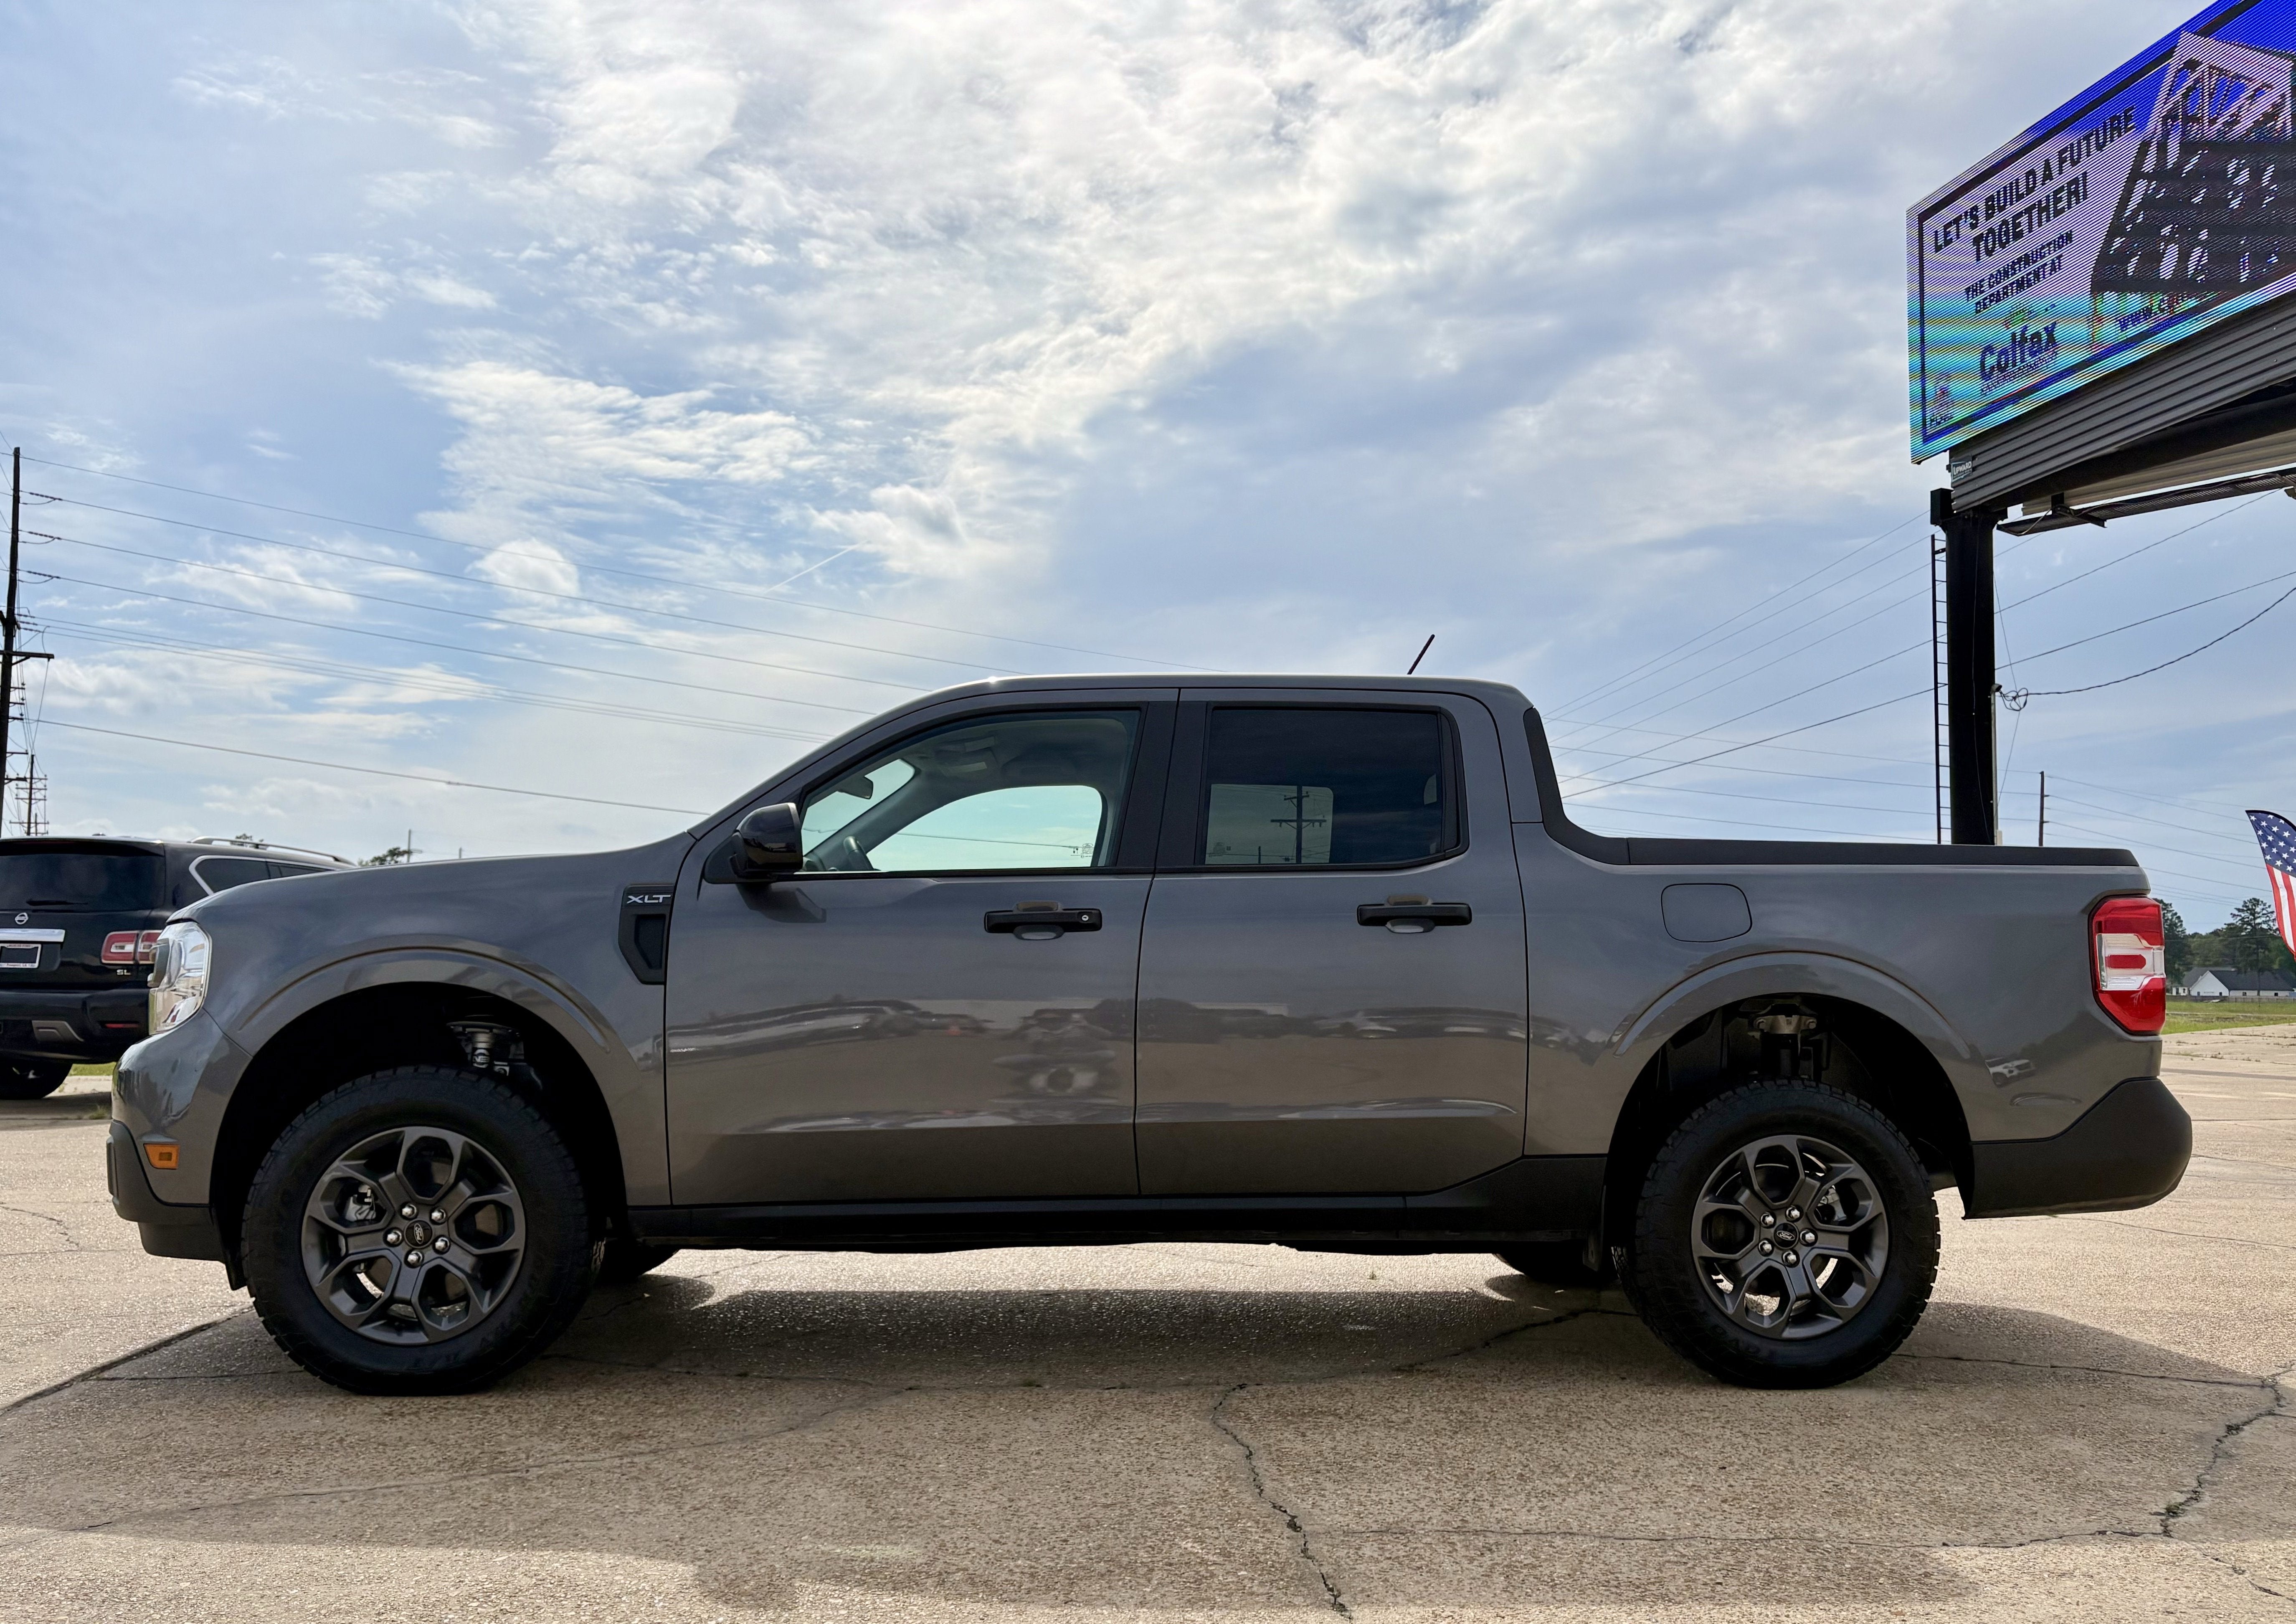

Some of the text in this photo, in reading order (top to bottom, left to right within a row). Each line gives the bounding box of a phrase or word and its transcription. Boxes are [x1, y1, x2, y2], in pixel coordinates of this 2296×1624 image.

[1934, 106, 2136, 253] LET'S BUILD A FUTURE
[1973, 172, 2088, 262] TOGETHER!
[1964, 230, 2073, 301] THE CONSTRUCTION
[1975, 254, 2063, 314] DEPARTMENT AT
[1980, 321, 2057, 381] Colfax
[1953, 461, 1972, 475] UPWARD
[627, 895, 671, 903] XLT
